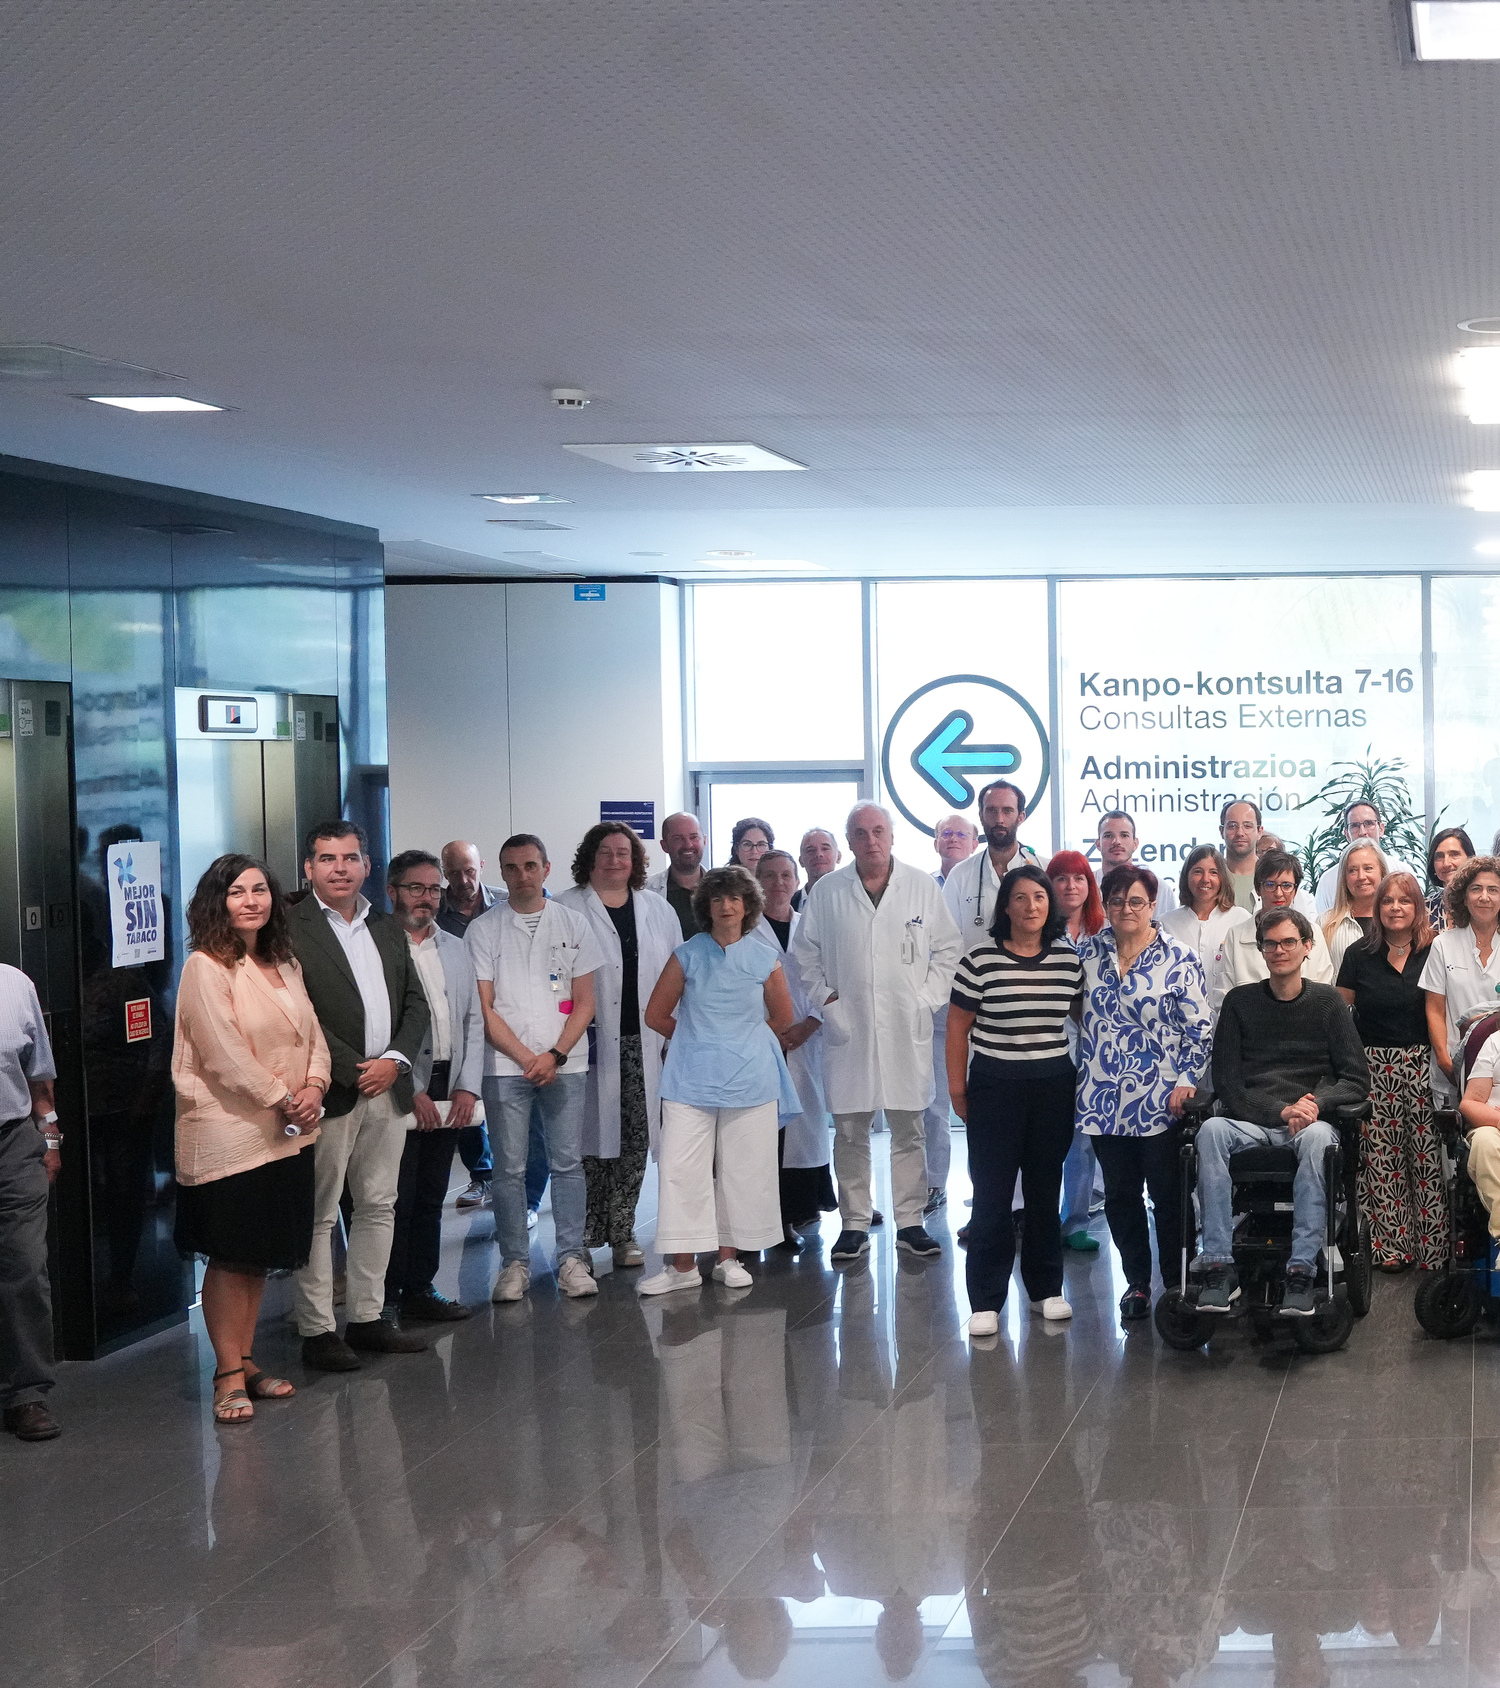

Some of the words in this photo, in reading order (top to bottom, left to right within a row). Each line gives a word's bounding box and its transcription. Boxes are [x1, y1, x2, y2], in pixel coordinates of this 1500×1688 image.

[1080, 670, 1343, 702] Kanpo-kontsulta
[1354, 668, 1414, 694] 7-16
[1080, 704, 1228, 730] Consultas
[1238, 703, 1368, 729] Externas
[1080, 753, 1317, 780] Administrazioa
[124, 884, 156, 901] MEJOR
[125, 899, 158, 932] SIN
[126, 928, 157, 946] TABACO
